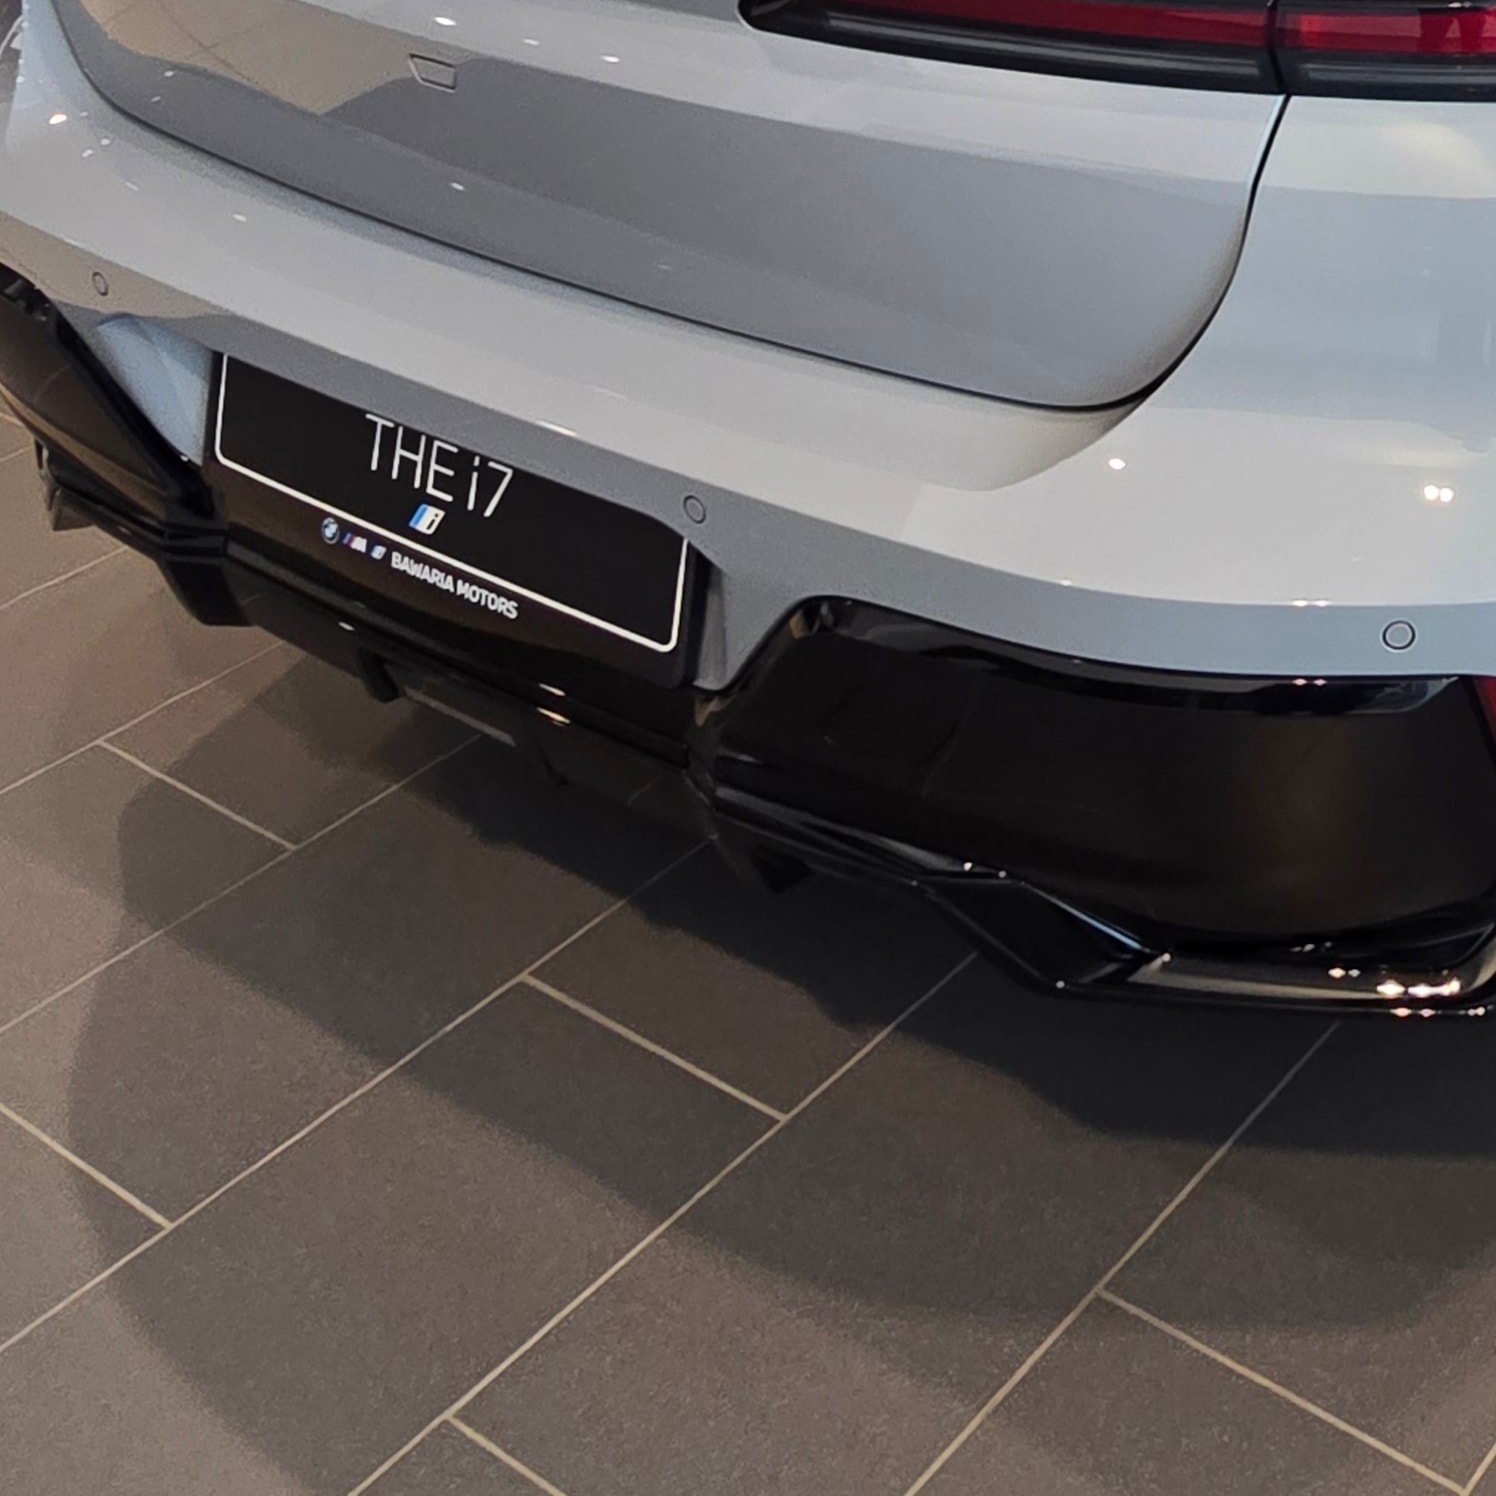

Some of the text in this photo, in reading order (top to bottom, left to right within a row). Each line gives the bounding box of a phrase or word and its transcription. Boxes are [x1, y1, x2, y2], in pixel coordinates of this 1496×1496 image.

[365, 413, 514, 518] THE i7
[390, 551, 519, 620] BAWARIA MOTORS
